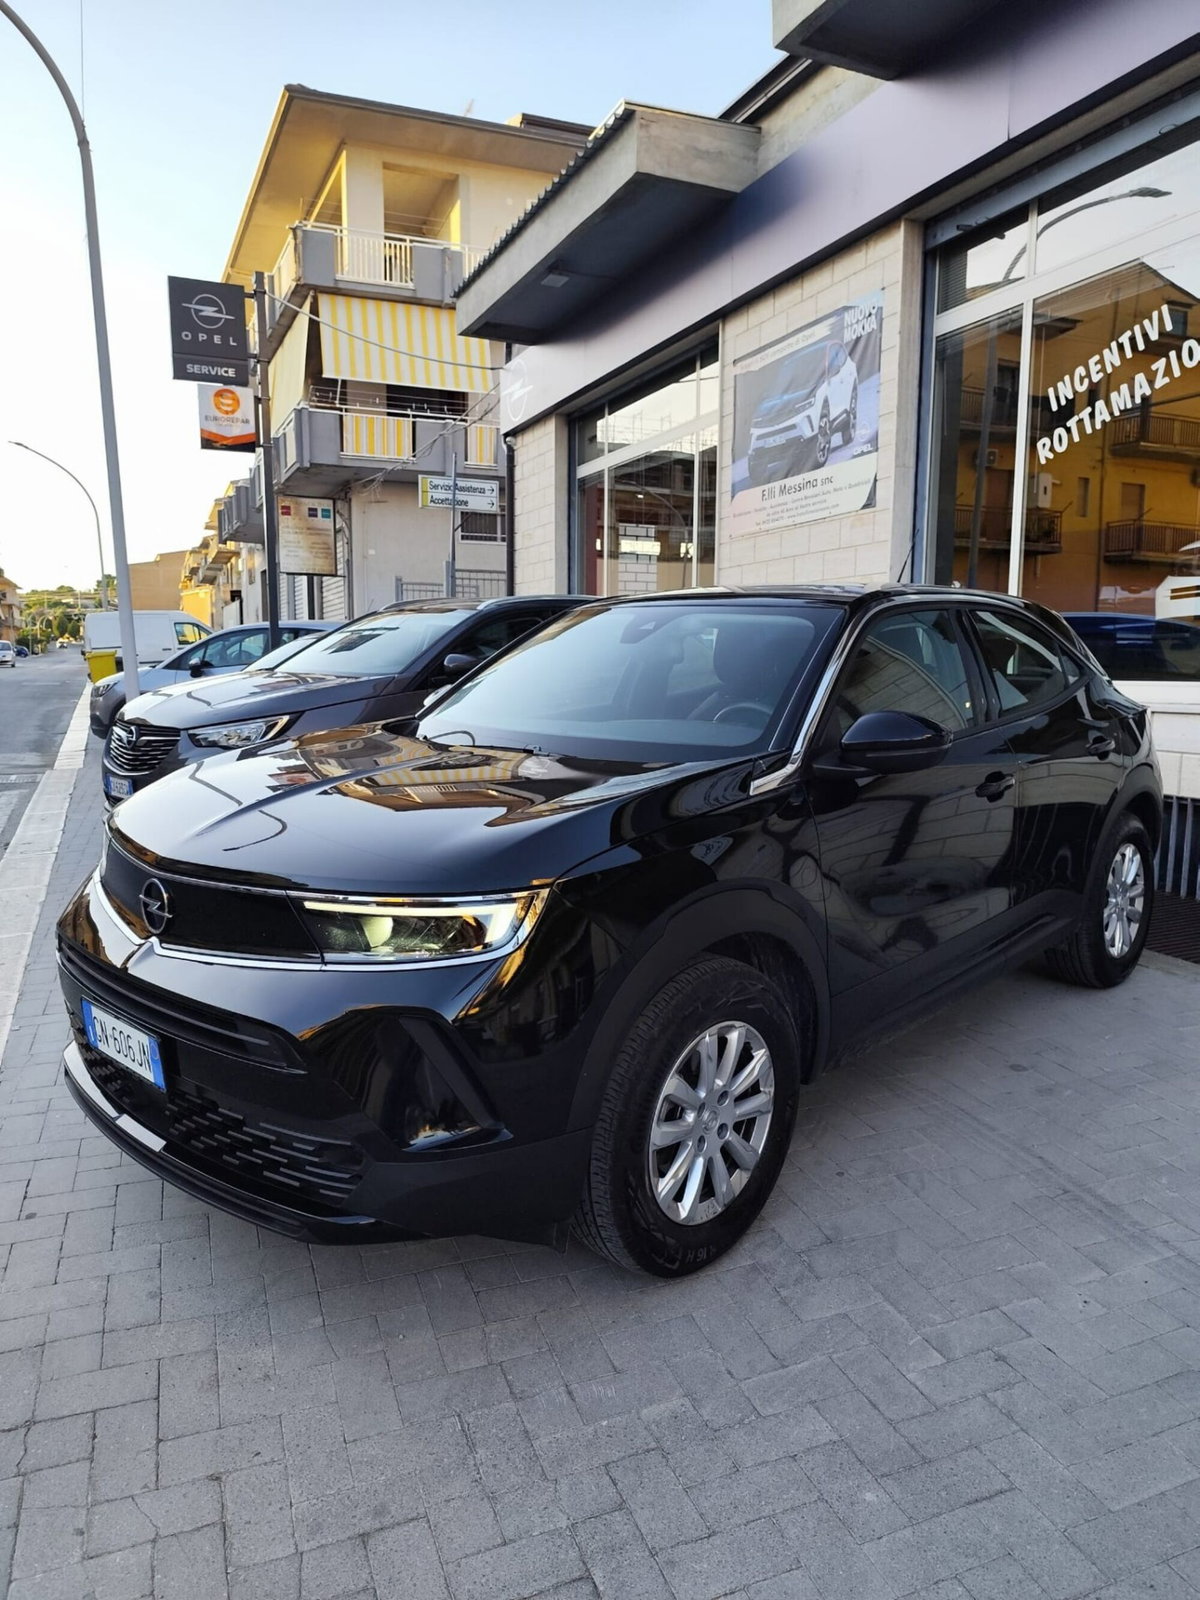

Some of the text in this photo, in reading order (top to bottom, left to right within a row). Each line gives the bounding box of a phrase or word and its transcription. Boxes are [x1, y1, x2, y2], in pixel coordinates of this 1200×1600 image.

[844, 303, 878, 326] NUOVO
[181, 331, 237, 346] OPEL
[1048, 304, 1173, 412] INCENTIVI
[186, 363, 236, 378] SERVICE
[1036, 339, 1200, 465] ROTTAMAZIO
[204, 414, 250, 425] EUROREPAR
[455, 482, 486, 495] Assistenza
[761, 485, 776, 502] F.lli
[779, 477, 818, 498] Messina
[820, 475, 834, 486] snc
